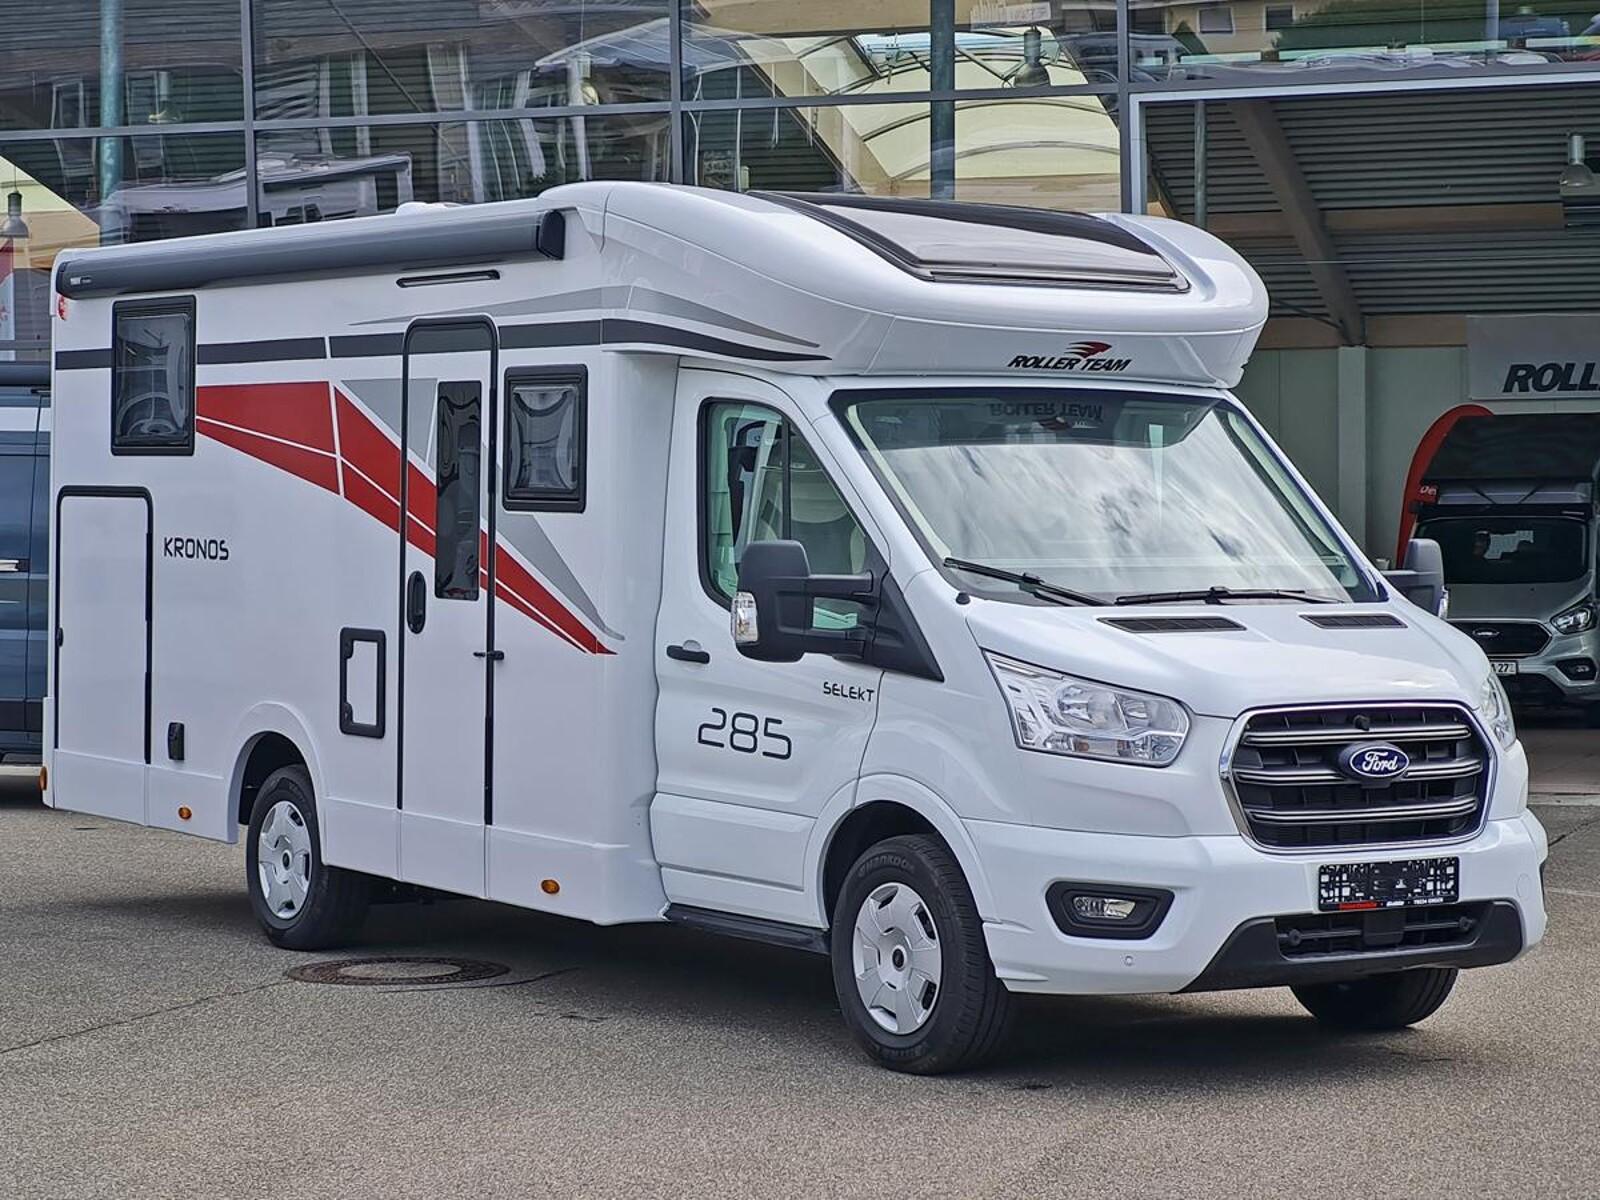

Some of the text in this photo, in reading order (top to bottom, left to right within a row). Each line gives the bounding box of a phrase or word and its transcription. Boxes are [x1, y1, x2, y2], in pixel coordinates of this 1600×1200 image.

[1007, 355, 1132, 372] ROLLER TEAM
[1502, 362, 1600, 393] ROLL
[163, 536, 229, 561] KRONOS
[823, 681, 875, 702] SELEKT
[698, 707, 792, 760] 285
[1361, 751, 1398, 772] Ford
